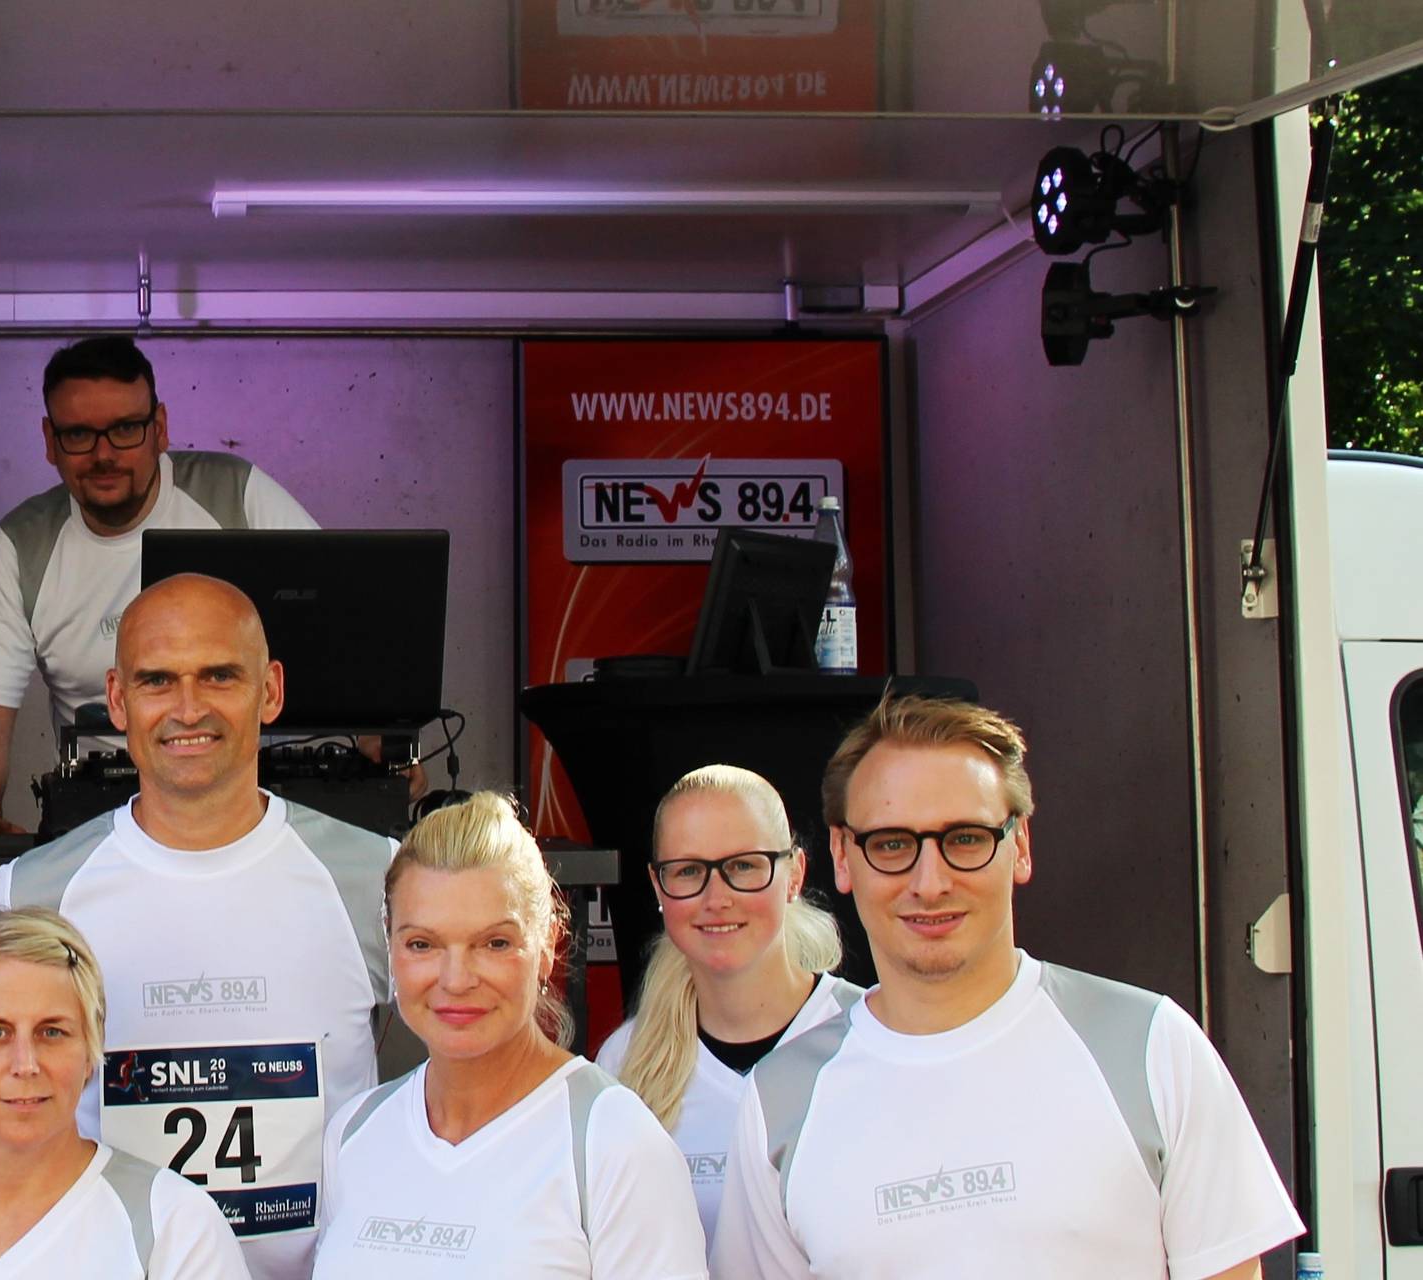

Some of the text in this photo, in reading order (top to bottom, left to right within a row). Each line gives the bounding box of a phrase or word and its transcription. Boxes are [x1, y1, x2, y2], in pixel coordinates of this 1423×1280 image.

[571, 392, 832, 422] WWW.NEWS894.DE
[593, 452, 814, 523] NEWS 89.4
[580, 534, 607, 548] Das
[616, 534, 658, 548] Radio
[667, 534, 684, 547] im
[587, 934, 612, 948] Das
[149, 972, 259, 1005] NEWS 89.4
[150, 1058, 226, 1087] SNL 20
[210, 1071, 227, 1084] 19
[252, 1060, 303, 1074] TG NEUSS
[164, 1105, 263, 1186] 24
[882, 1164, 1007, 1210] NEWS 89.4
[255, 1195, 311, 1215] RheinLand
[365, 1217, 467, 1248] NEWS 89.4
